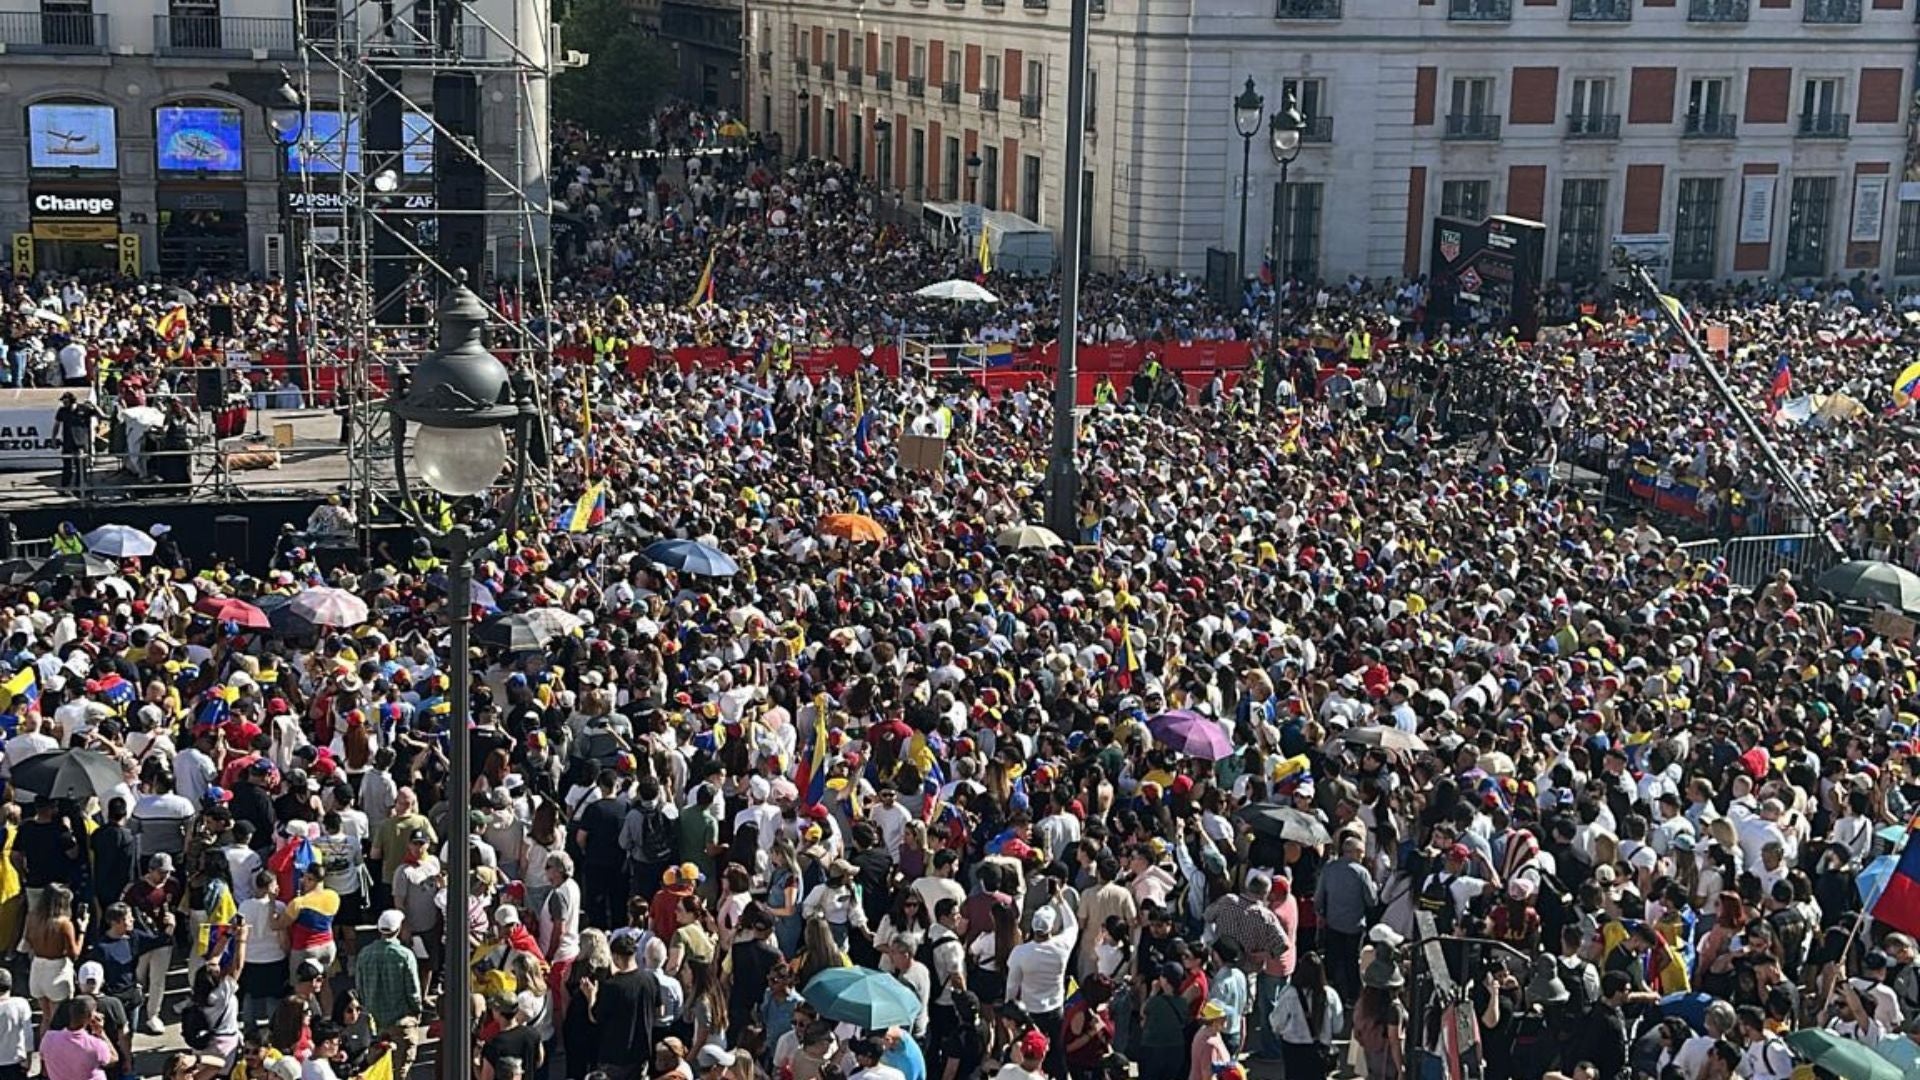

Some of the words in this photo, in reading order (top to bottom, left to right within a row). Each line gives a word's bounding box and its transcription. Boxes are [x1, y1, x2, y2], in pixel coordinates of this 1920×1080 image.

[35, 195, 114, 214] Change
[1, 426, 12, 437] A
[16, 426, 39, 437] LA
